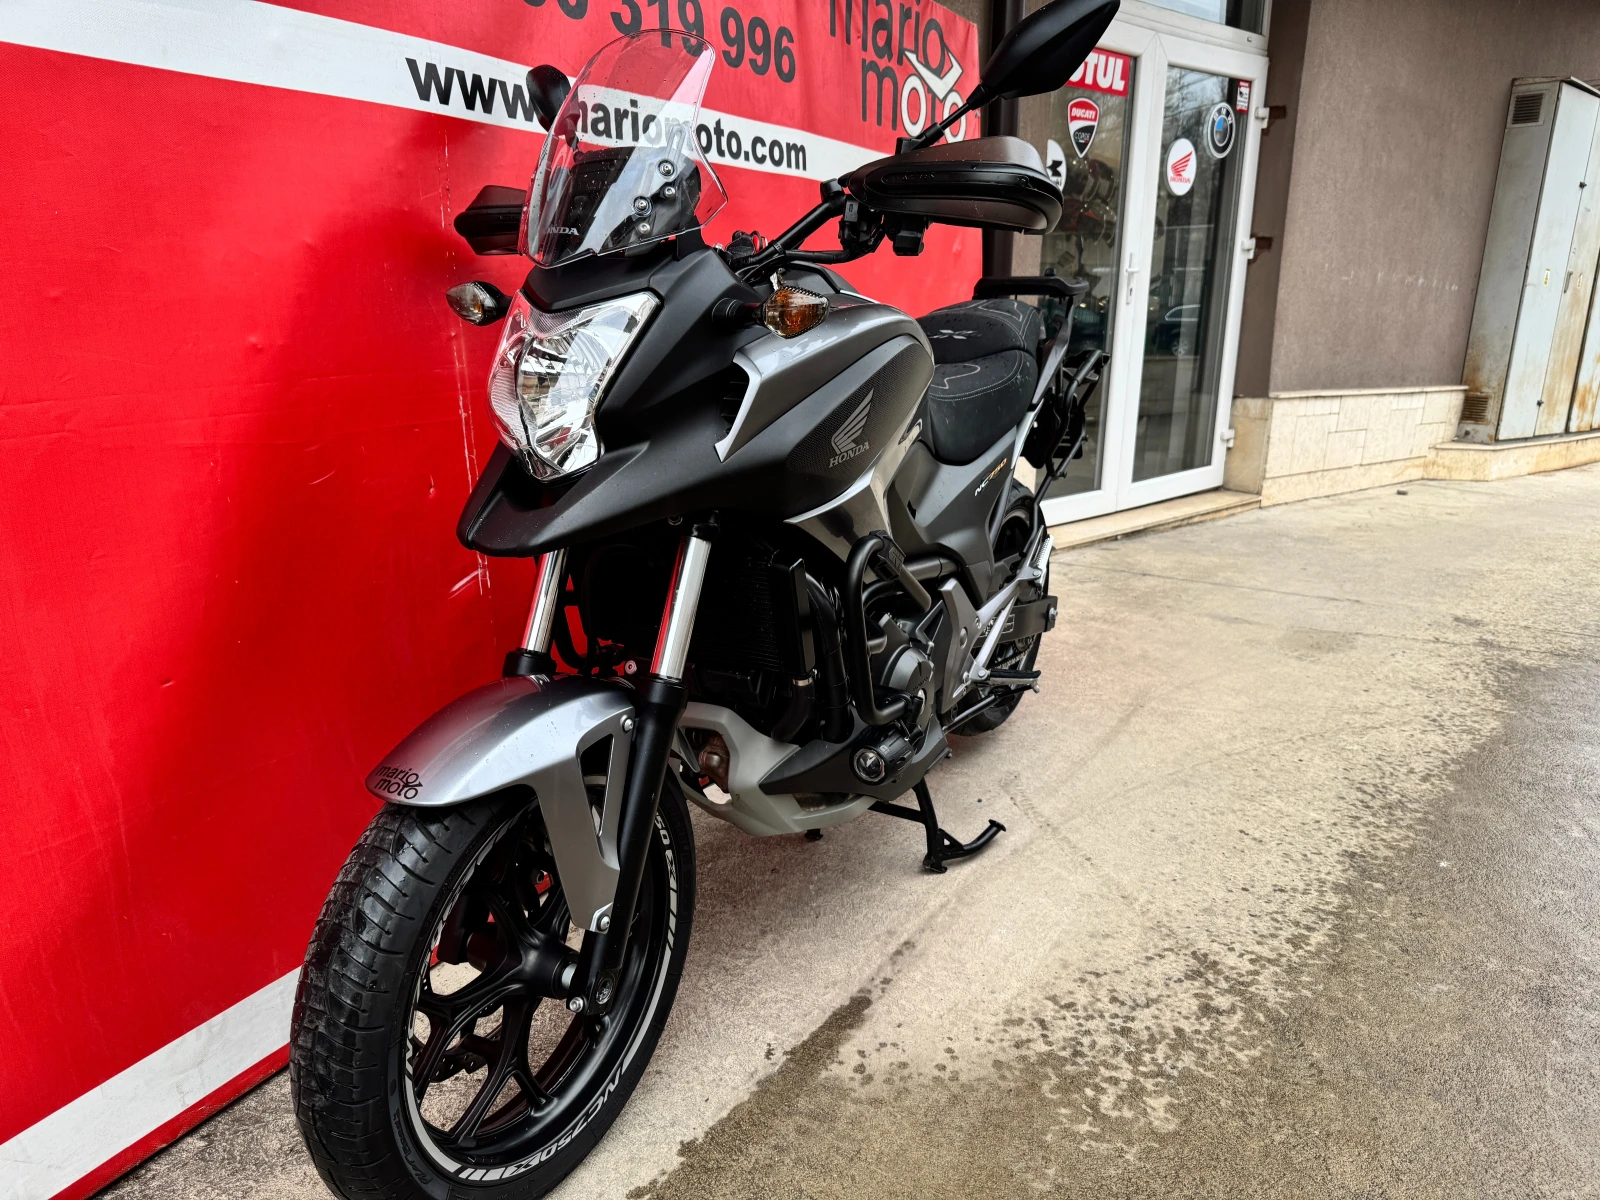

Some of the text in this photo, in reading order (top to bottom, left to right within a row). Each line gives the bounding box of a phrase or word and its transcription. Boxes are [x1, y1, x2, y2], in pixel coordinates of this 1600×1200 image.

[610, 0, 796, 83] 319 996
[829, 0, 946, 77] mario
[405, 57, 807, 171] wwwariomoto.com
[1071, 107, 1096, 119] DUCATI
[1212, 107, 1232, 124] BMW
[829, 441, 869, 468] HONDA
[376, 766, 419, 784] mario
[374, 778, 419, 800] moto
